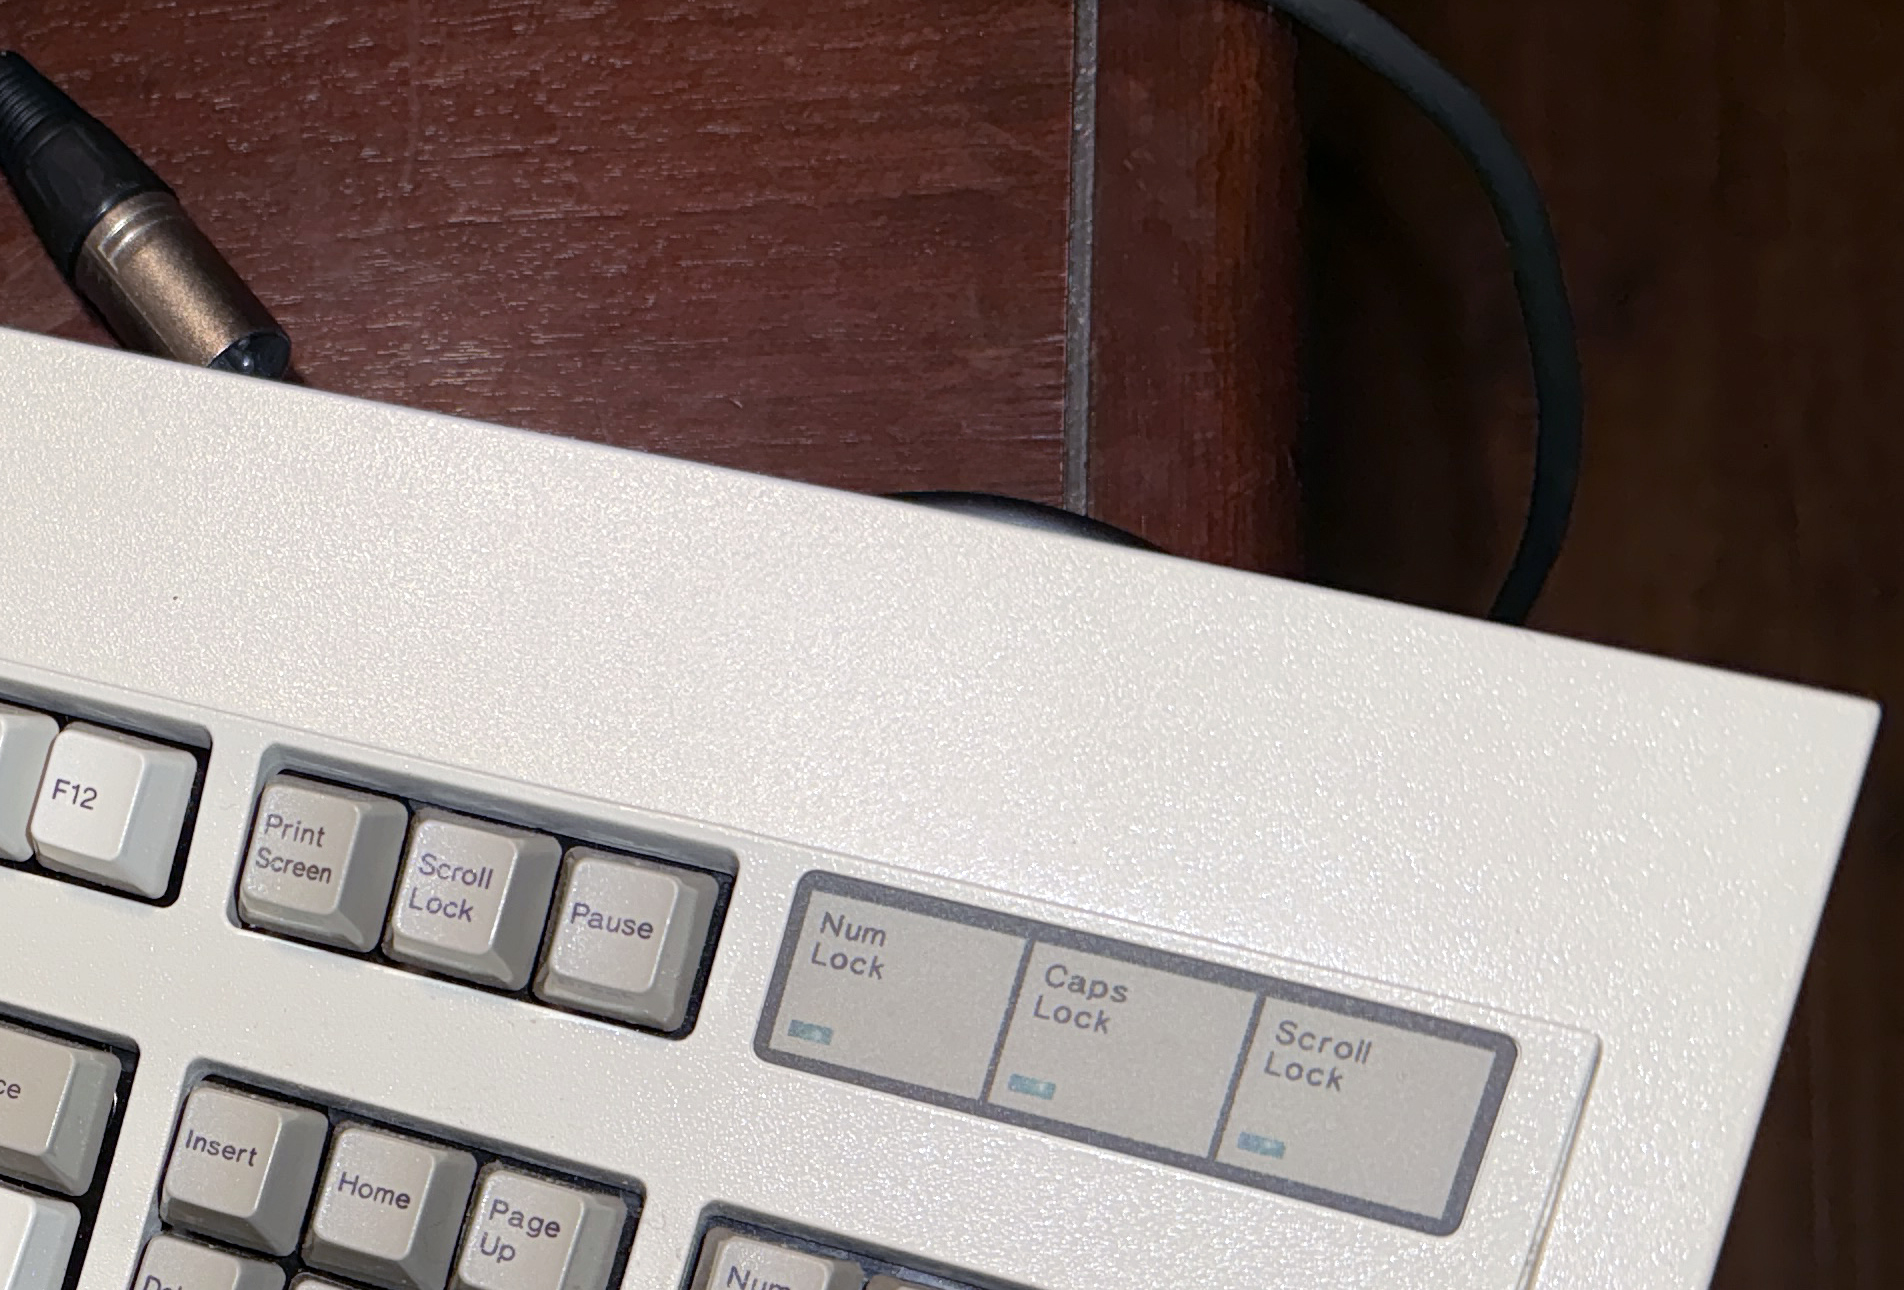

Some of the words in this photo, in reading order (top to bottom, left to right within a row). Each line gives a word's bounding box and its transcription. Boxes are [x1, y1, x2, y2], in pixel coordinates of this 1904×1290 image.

[51, 778, 98, 811] F12
[264, 813, 326, 848] Print
[255, 847, 333, 884] Screen
[419, 853, 494, 890] Scroll
[408, 887, 474, 923] Lock
[570, 902, 654, 940] Pause
[819, 911, 887, 947] Num
[810, 941, 885, 980] Lock
[1044, 963, 1129, 1004] Caps
[1032, 994, 1111, 1034] Lock
[1275, 1019, 1373, 1065] Scroll
[1263, 1055, 1345, 1092] Lock
[185, 1129, 258, 1168] Insert
[337, 1171, 411, 1210] Home
[489, 1199, 561, 1239] Page
[479, 1231, 516, 1264] Up
